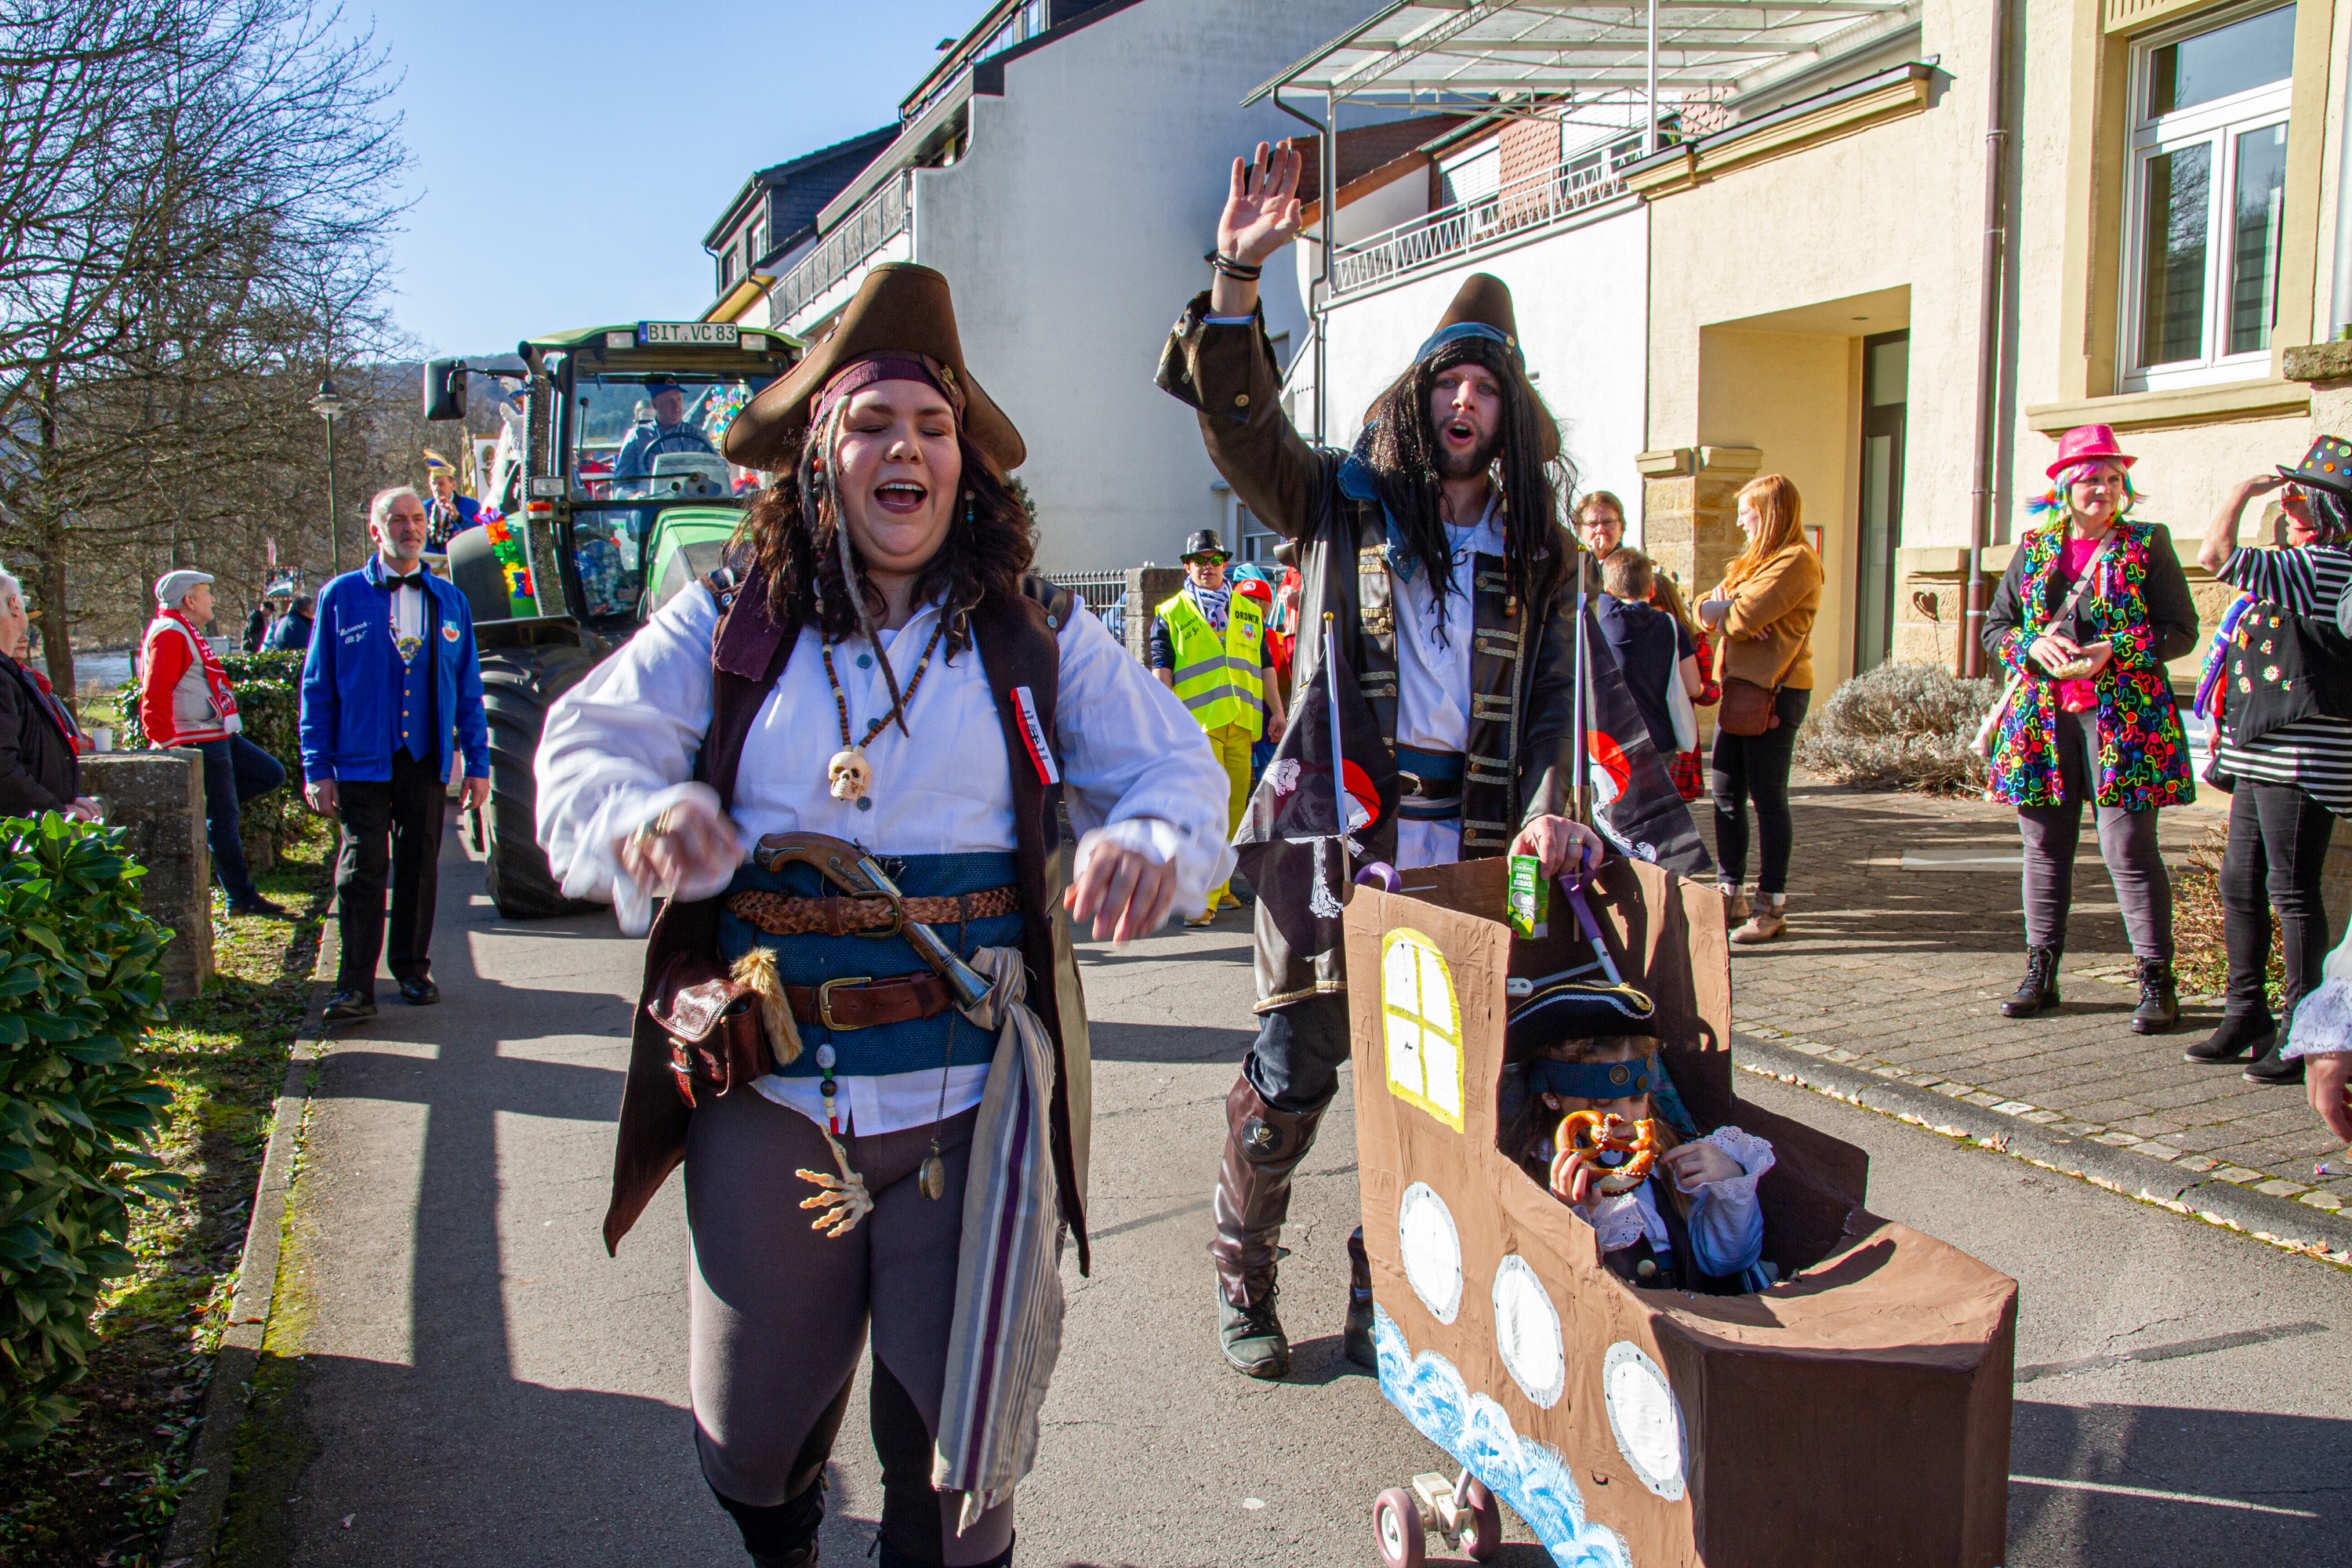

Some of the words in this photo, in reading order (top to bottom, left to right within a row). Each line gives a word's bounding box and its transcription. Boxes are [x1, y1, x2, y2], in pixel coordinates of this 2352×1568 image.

[648, 325, 681, 341] BIT
[691, 325, 712, 341] VC
[716, 325, 735, 341] 83
[1235, 610, 1259, 626] ORDNER
